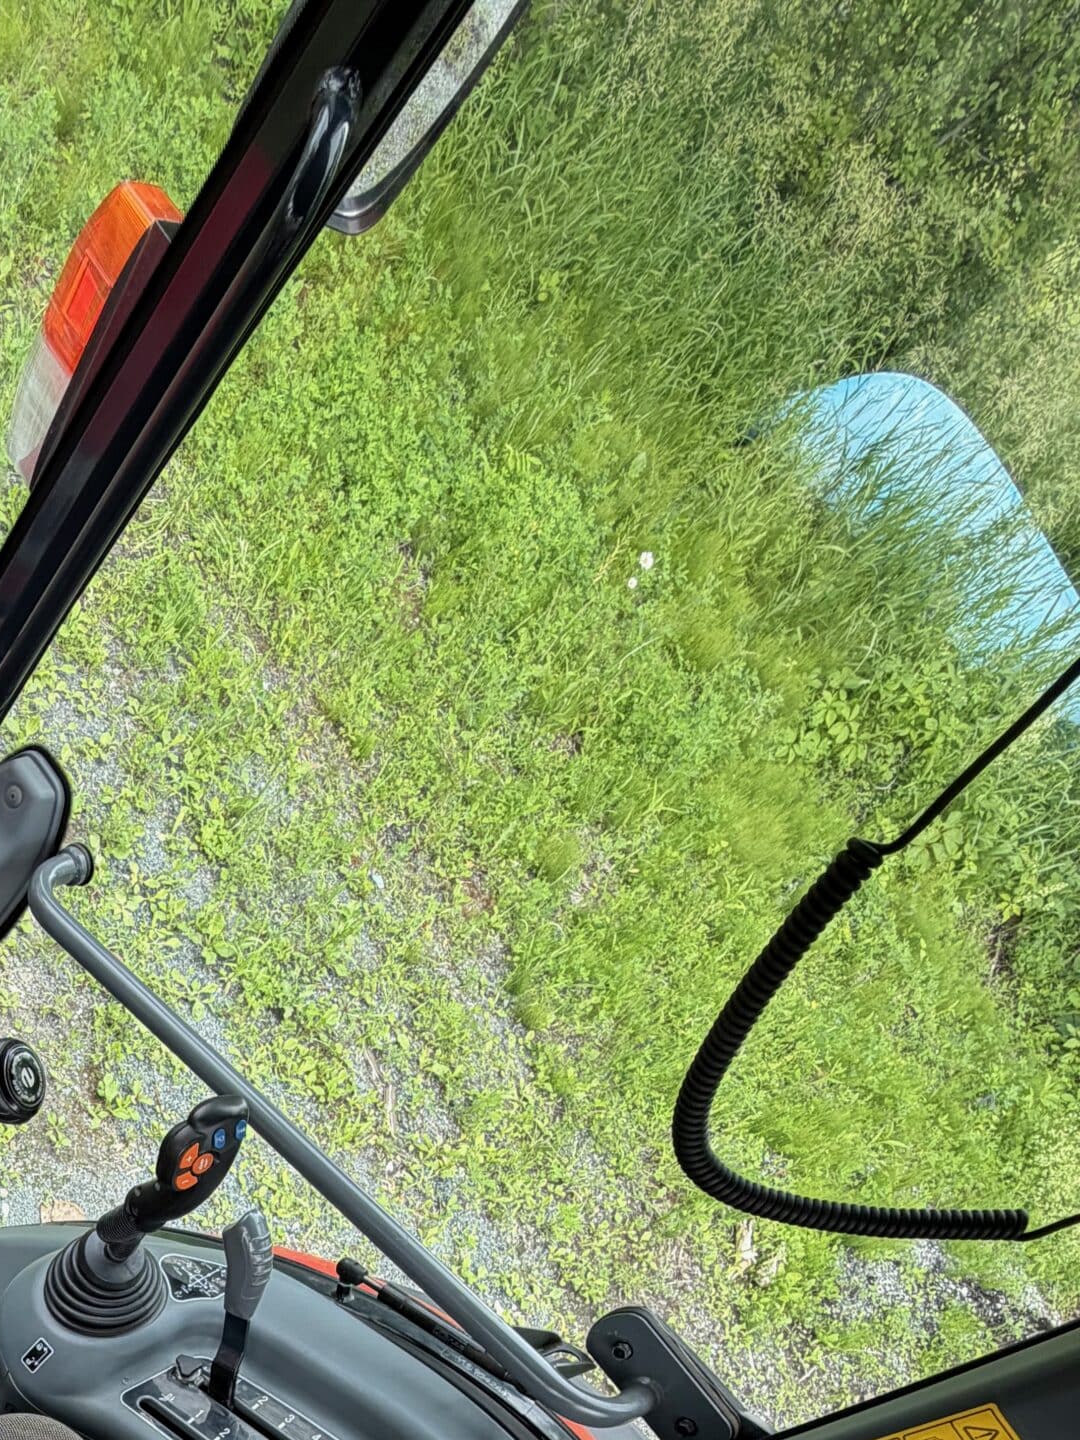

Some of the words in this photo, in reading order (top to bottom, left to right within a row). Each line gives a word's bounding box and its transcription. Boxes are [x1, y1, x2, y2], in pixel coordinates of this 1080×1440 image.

[257, 1395, 269, 1406] 2
[285, 1414, 296, 1425] 3
[219, 1427, 231, 1439] 2
